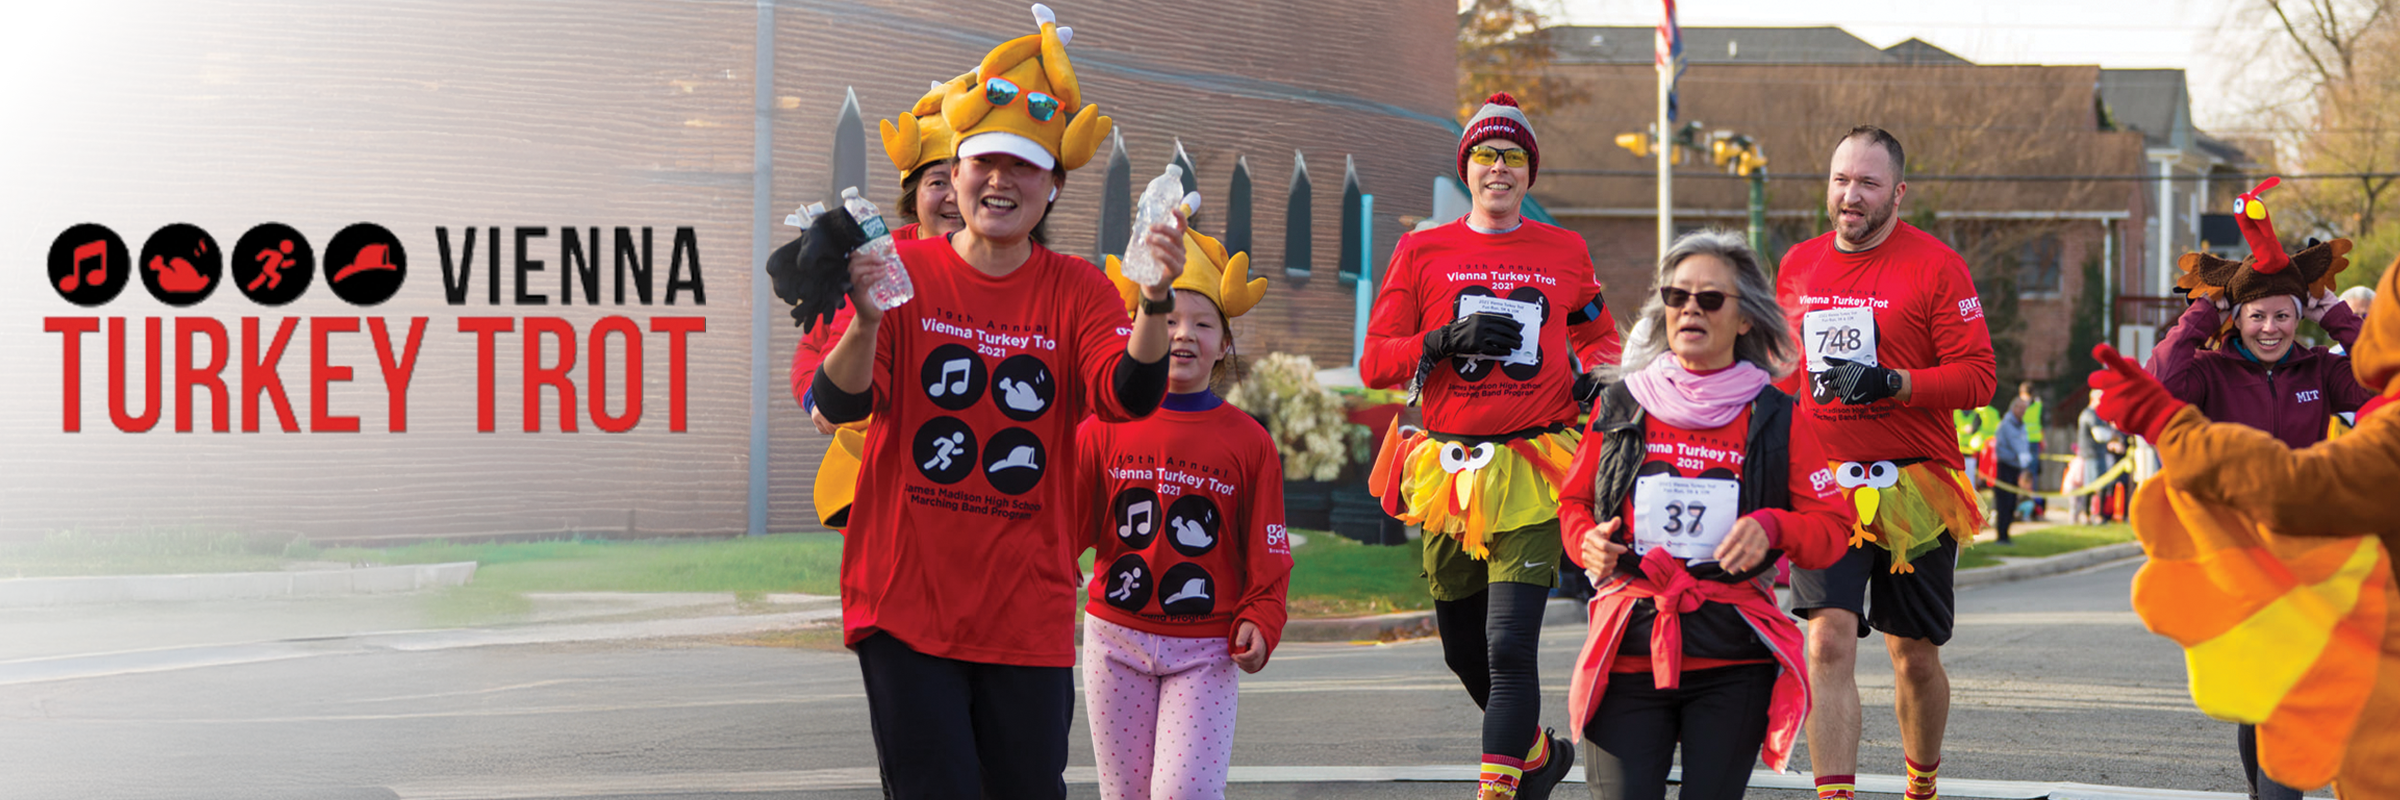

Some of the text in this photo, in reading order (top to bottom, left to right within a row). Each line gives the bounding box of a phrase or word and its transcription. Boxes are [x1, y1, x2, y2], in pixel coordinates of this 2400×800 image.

[1498, 263, 1547, 273] Annual
[1446, 271, 1557, 286] Vienna Turkey Trot
[1491, 282, 1514, 290] 2021
[1800, 295, 1889, 308] Vienna Turkey Trot
[937, 307, 1048, 335] 19th Annual
[921, 317, 1056, 350] Vienna Turkey Tro
[1816, 328, 1861, 353] 748
[977, 343, 1006, 358] 2021
[1481, 389, 1502, 397] Band
[1499, 382, 1518, 390] High
[2295, 389, 2319, 403] MIT
[1650, 431, 1739, 449] 9th Annua
[1677, 442, 1726, 462] Turkey
[1729, 450, 1745, 464] Tr
[1119, 454, 1228, 478] 19th Annual
[1677, 456, 1705, 470] 2021
[1156, 467, 1205, 489] Turkey
[1208, 477, 1235, 496] Trot
[1157, 483, 1181, 496] 2021
[938, 488, 982, 503] Madison
[984, 495, 1009, 509] High
[910, 494, 1032, 520] Marching Band Program
[1663, 504, 1706, 534] 37
